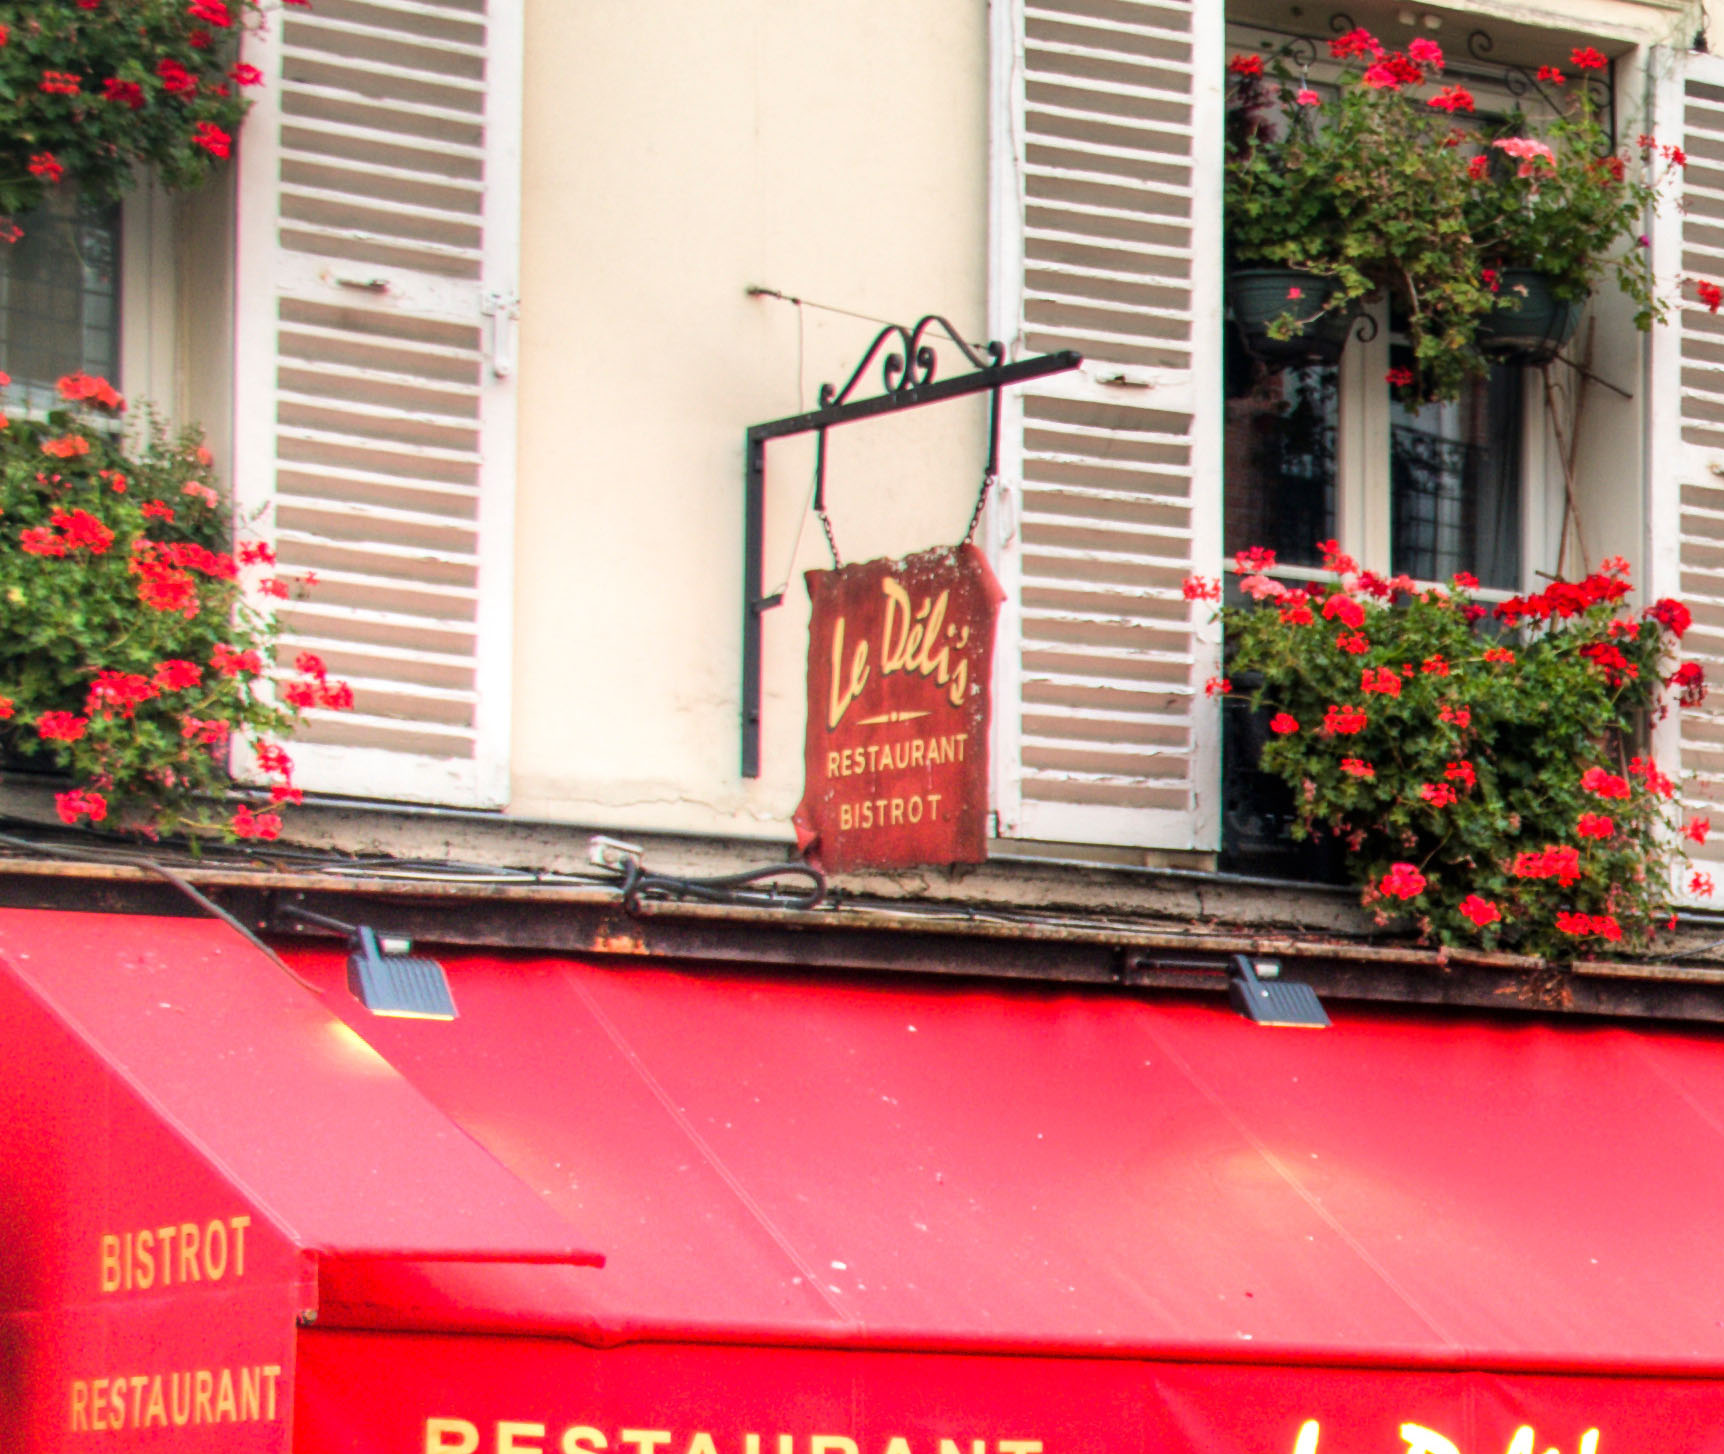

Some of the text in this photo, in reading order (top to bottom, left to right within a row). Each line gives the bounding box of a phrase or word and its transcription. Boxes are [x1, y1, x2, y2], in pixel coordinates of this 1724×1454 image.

[828, 616, 871, 731] Le
[827, 734, 968, 778] RESTAURANT
[840, 795, 941, 830] BISTROT
[101, 1216, 252, 1293] BISTROT
[70, 1365, 281, 1432] RESTAURANT
